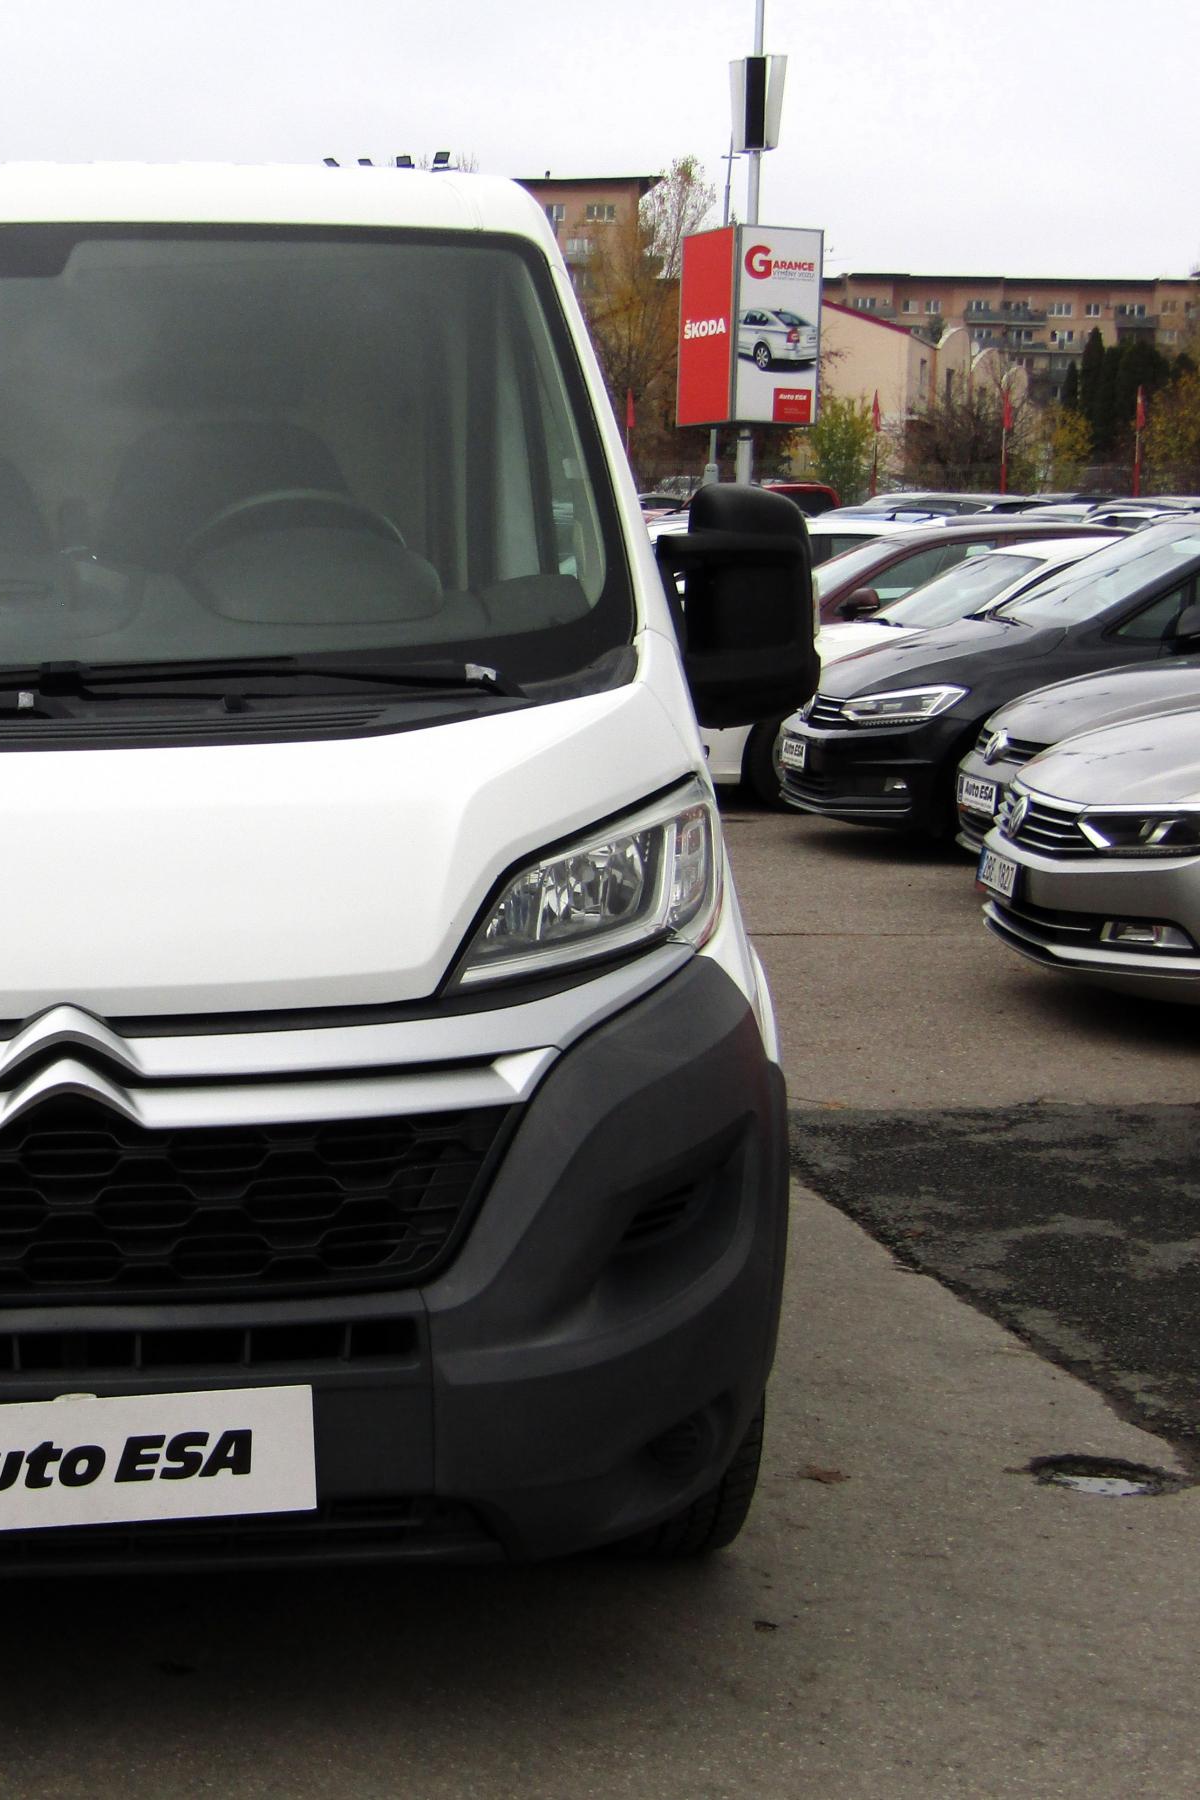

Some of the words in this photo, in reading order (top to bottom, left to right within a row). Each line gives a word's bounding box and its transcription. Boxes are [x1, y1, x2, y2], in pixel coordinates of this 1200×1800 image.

[744, 245, 815, 280] GARANCE
[684, 318, 726, 340] ŠKODA
[965, 781, 979, 798] Auto
[980, 784, 994, 802] ESA
[999, 861, 1015, 891] 1827
[114, 1428, 252, 1483] ESA
